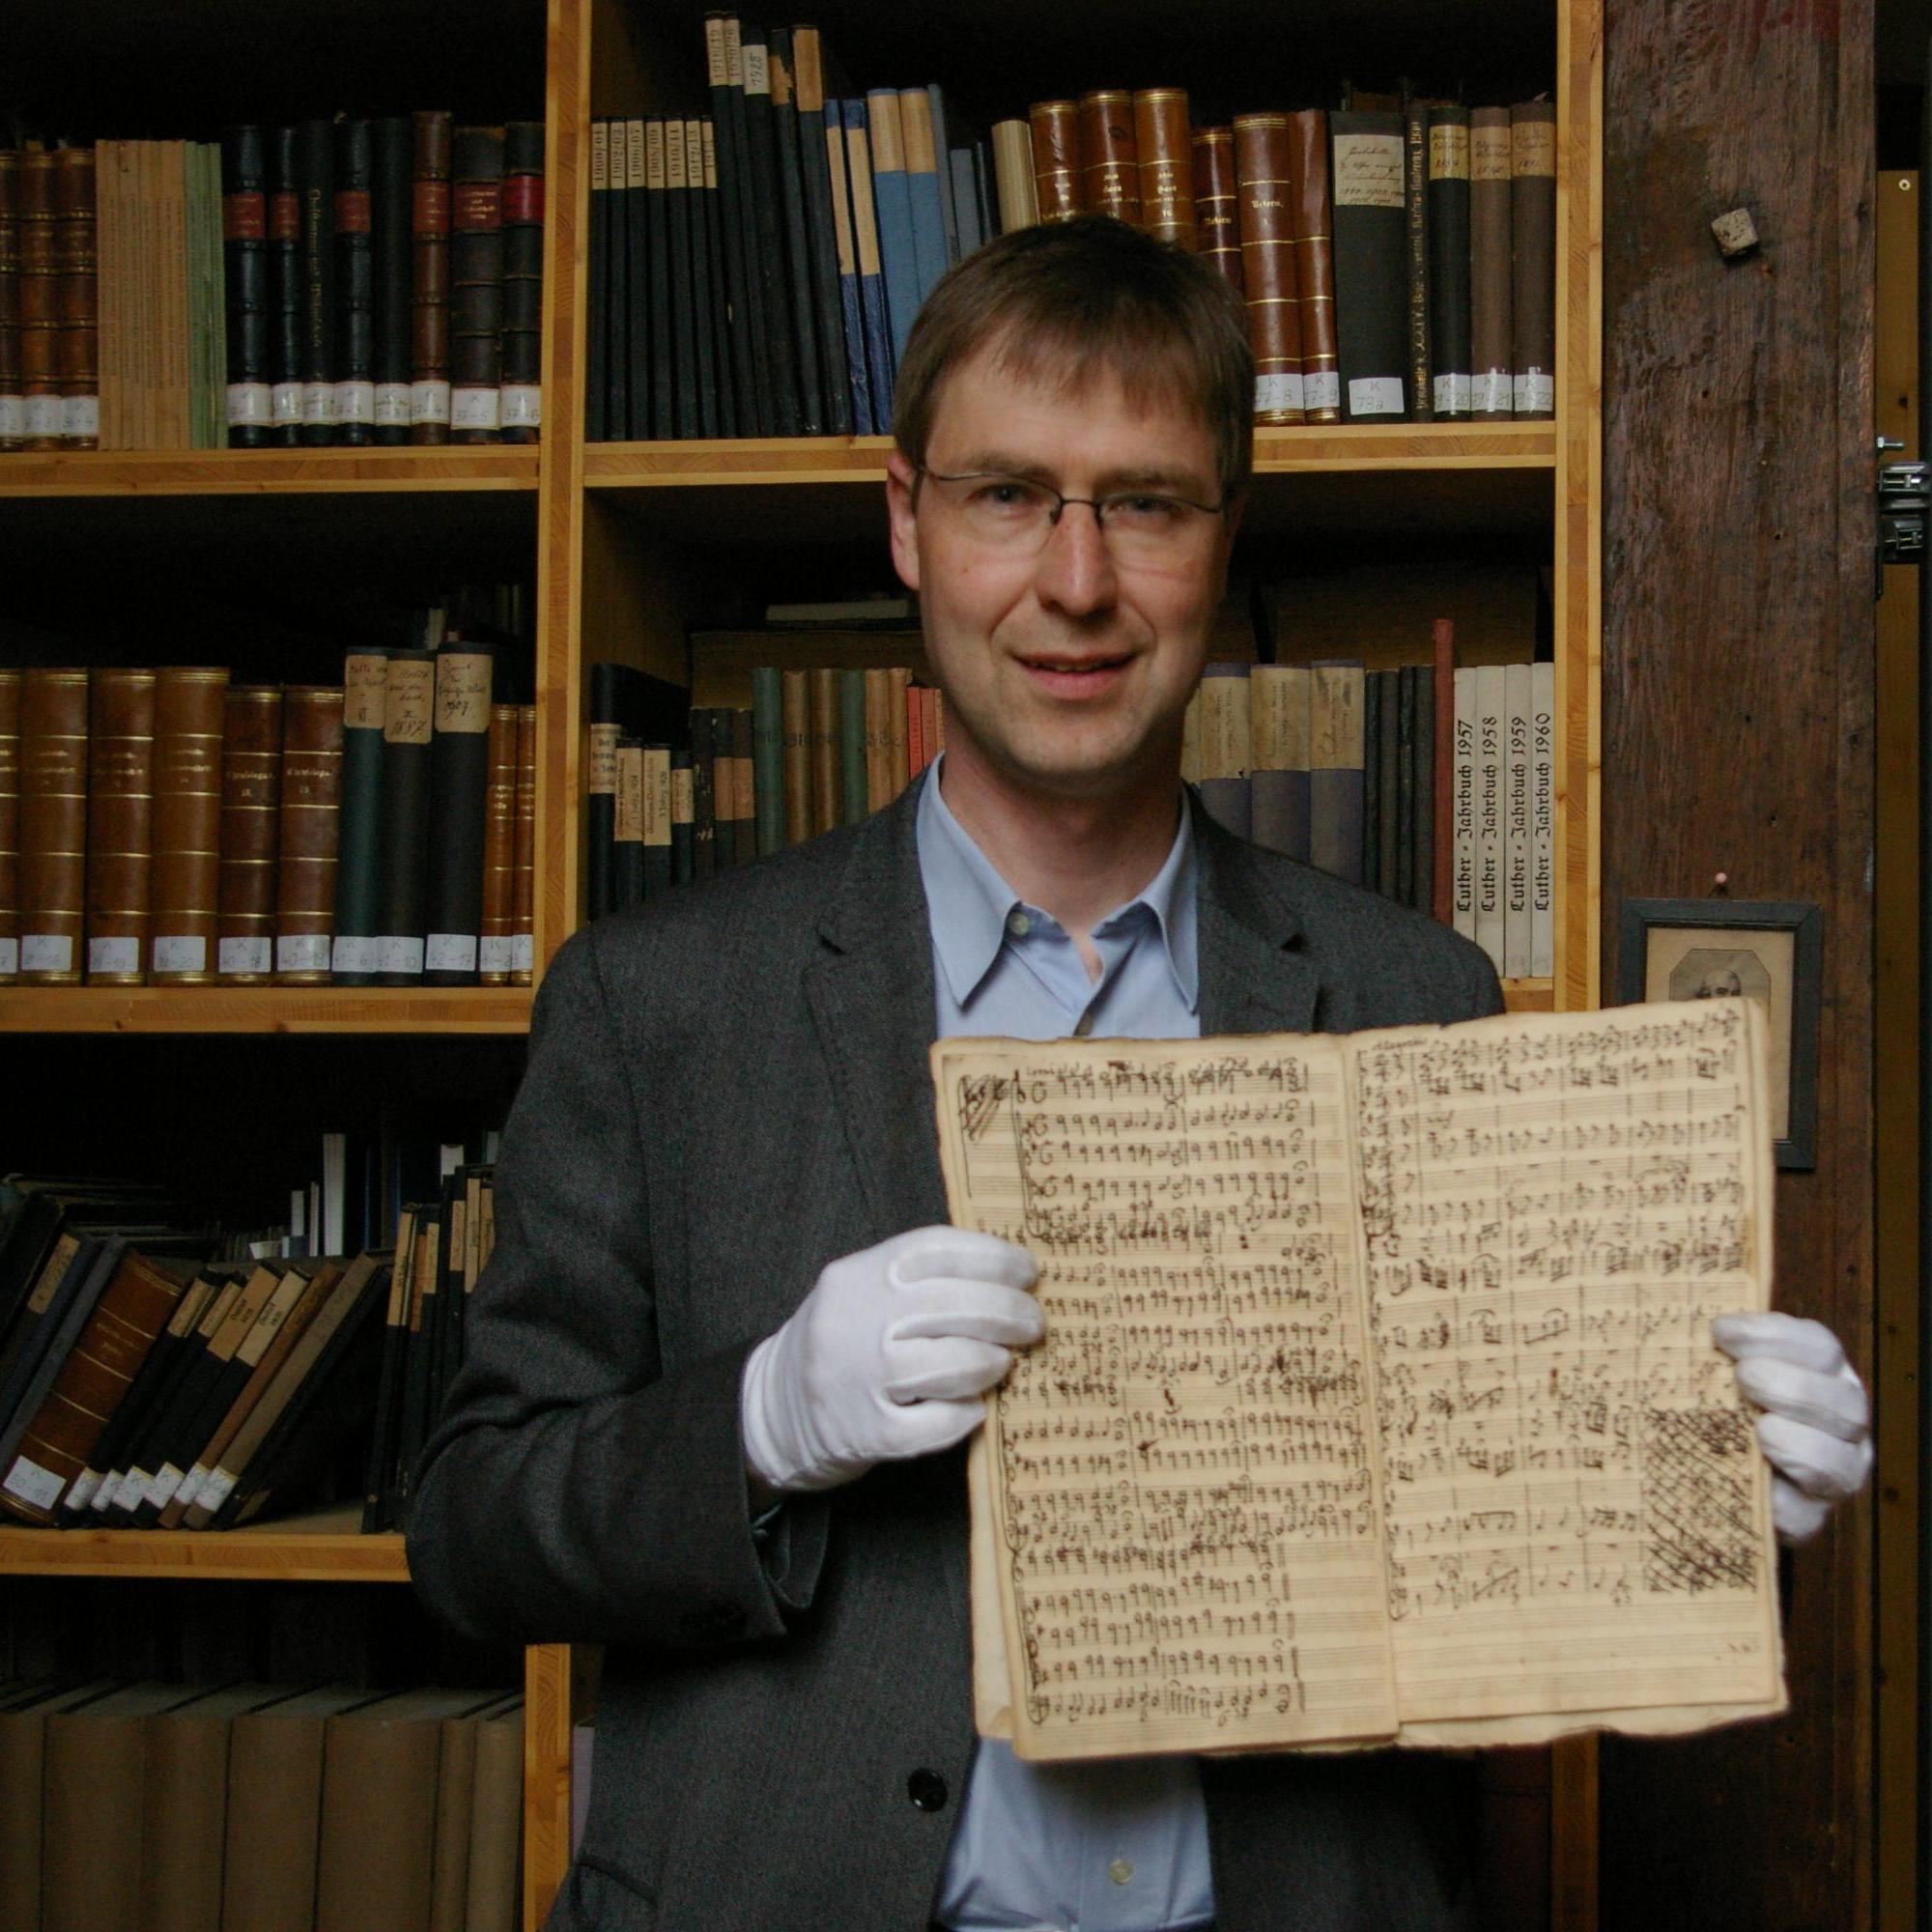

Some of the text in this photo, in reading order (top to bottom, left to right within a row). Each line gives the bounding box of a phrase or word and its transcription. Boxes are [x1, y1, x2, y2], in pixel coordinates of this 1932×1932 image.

[1268, 377, 1278, 387] K
[1316, 374, 1324, 385] K
[1370, 381, 1381, 391] K
[1458, 719, 1473, 755] 1957
[1483, 717, 1497, 755] 1958
[1512, 717, 1526, 755] 1959
[1536, 712, 1550, 754] 1960
[1457, 764, 1473, 838] Jahrbuch
[1482, 764, 1497, 838] Jahrbuch
[1511, 763, 1526, 838] Jahrbuch
[1535, 762, 1550, 838] Jahrbuch
[1457, 858, 1472, 912] Luther
[1482, 858, 1496, 912] Luther
[1511, 857, 1525, 912] Luther
[1535, 857, 1549, 911] Luther
